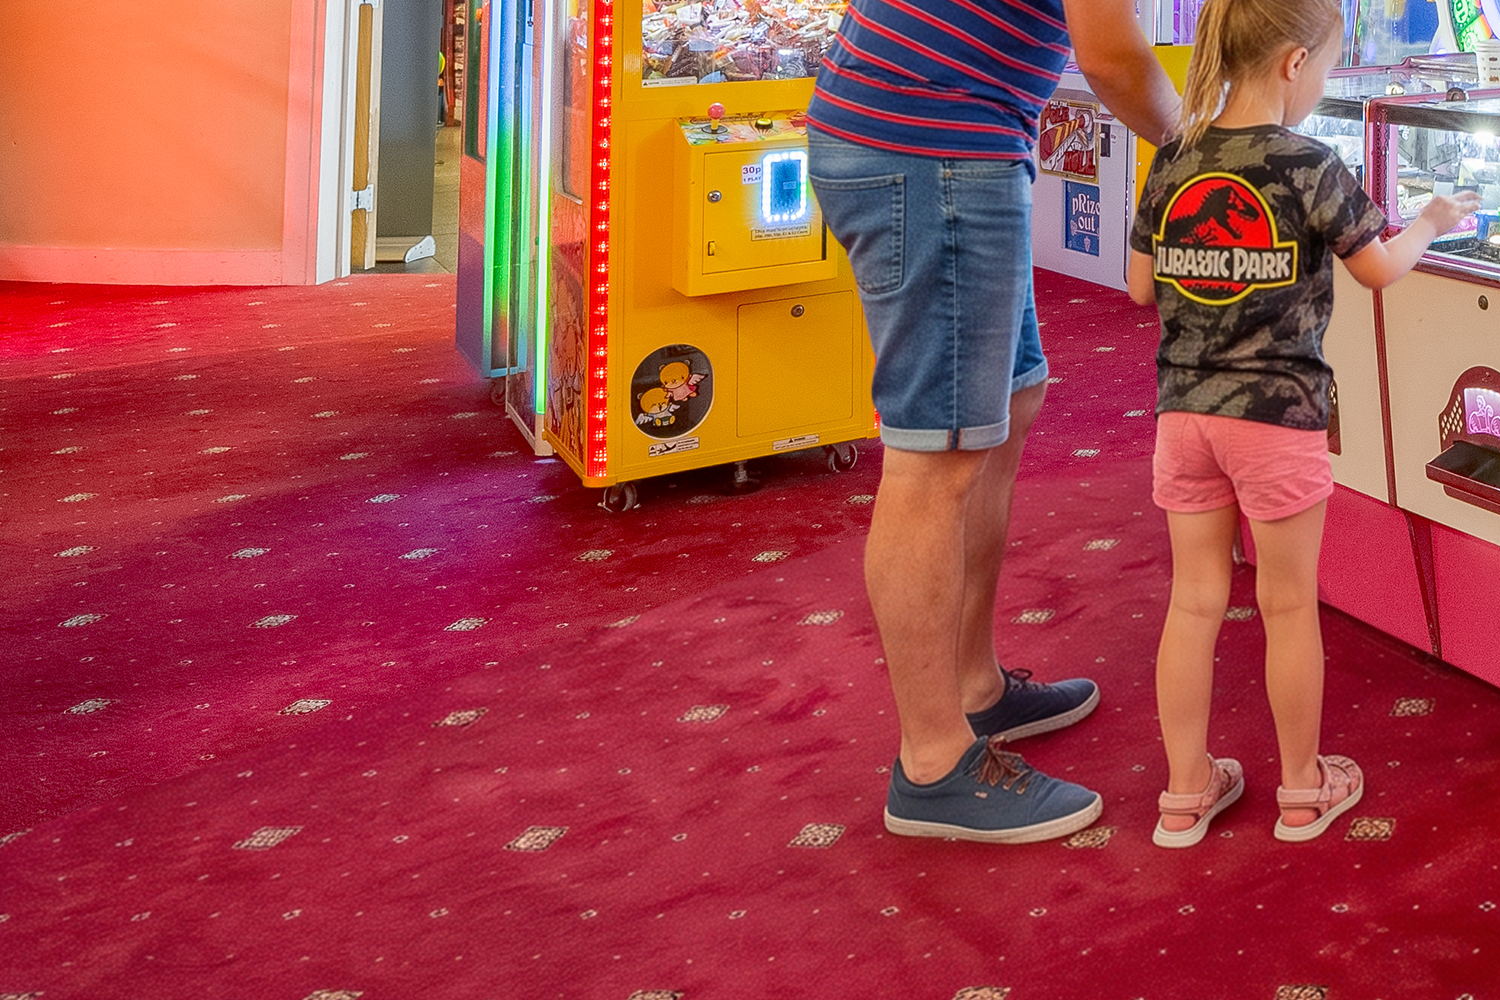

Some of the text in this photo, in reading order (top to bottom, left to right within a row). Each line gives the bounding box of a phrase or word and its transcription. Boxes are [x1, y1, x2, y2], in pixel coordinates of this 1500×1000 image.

[742, 166, 762, 175] 30p
[1078, 217, 1095, 232] out
[1157, 246, 1291, 281] JURASSIC PARK
